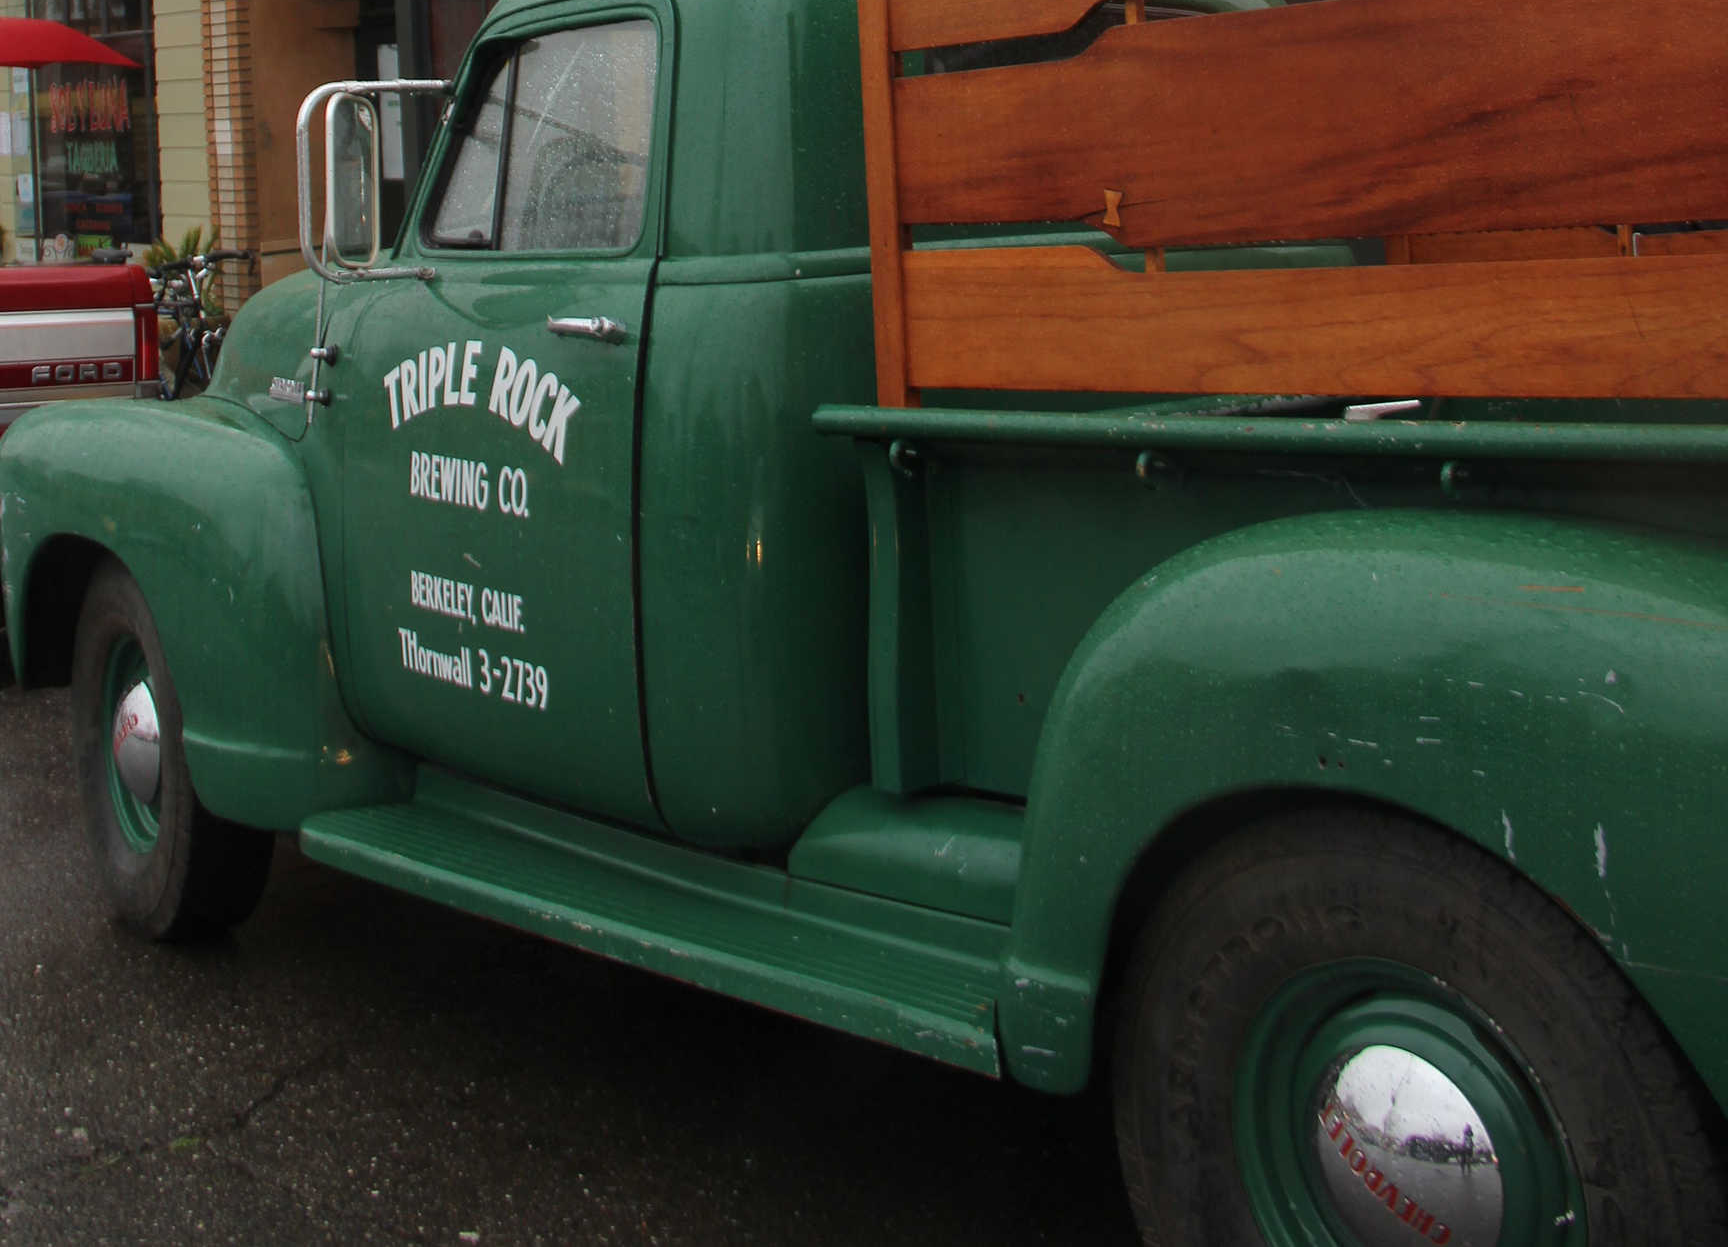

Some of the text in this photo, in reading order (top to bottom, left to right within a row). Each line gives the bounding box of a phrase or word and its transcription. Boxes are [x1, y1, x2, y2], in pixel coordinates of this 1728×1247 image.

[49, 82, 76, 133] SOL
[76, 78, 87, 132] Y
[88, 74, 130, 132] LUNA
[32, 362, 122, 384] FORD
[383, 340, 581, 466] TRIPLE ROCK
[410, 450, 530, 518] BREWING CO.
[411, 570, 524, 633] BERKELEY, CALIF.
[399, 626, 548, 711] THornwall 3-2739
[1318, 1102, 1452, 1245] CHEVROLET
